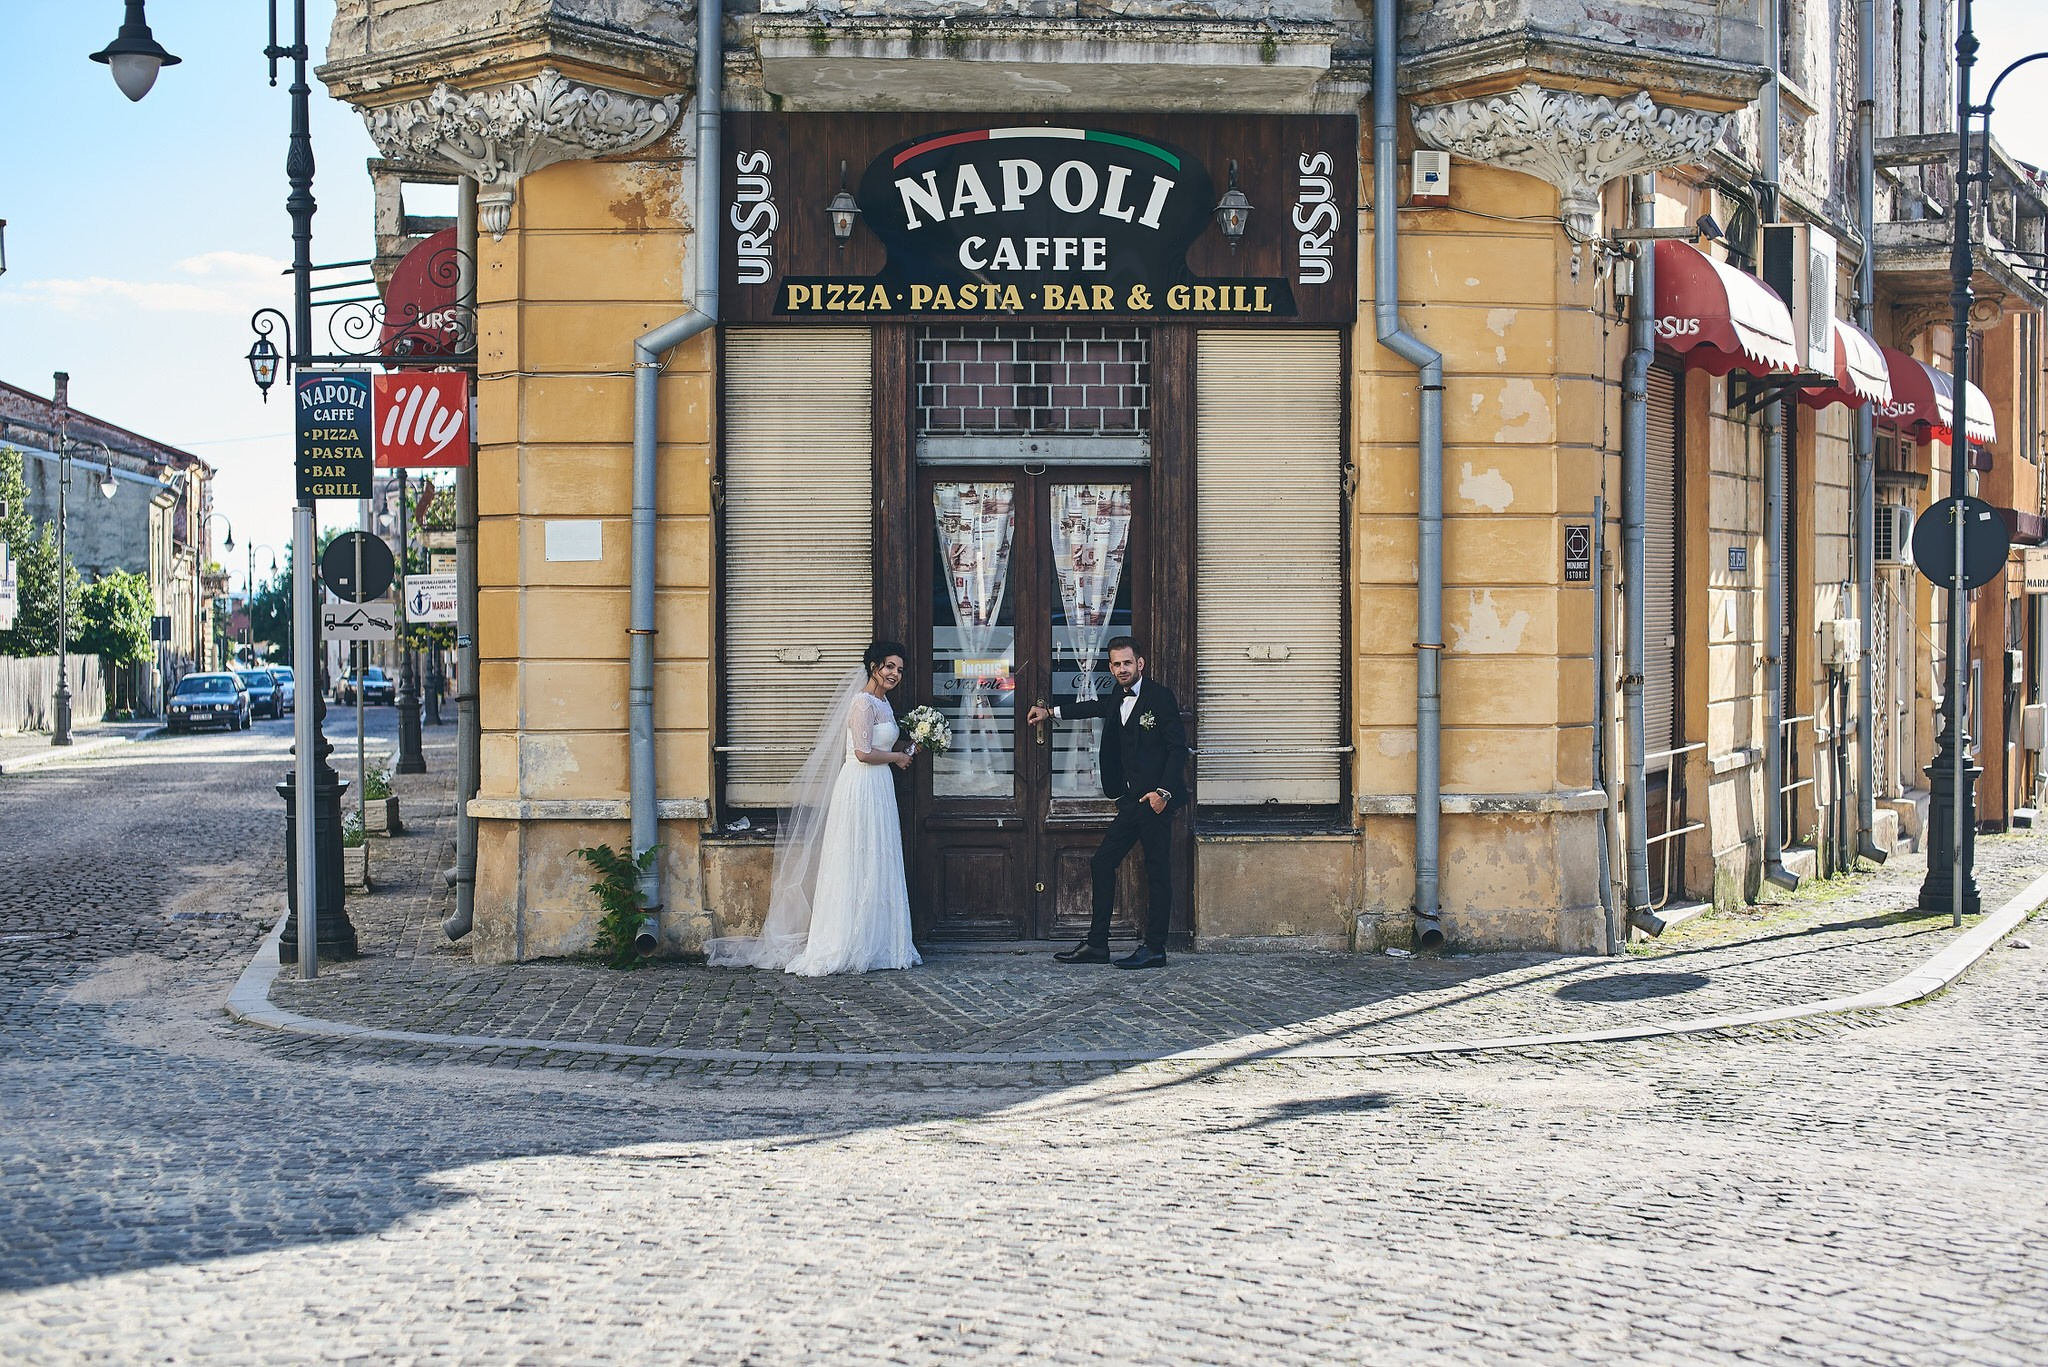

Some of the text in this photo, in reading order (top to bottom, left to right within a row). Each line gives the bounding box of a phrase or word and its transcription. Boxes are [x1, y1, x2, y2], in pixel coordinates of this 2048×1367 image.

[894, 158, 1176, 231] NAPOLI
[730, 149, 779, 285] URSUS
[1292, 151, 1341, 285] URSUS
[959, 235, 1107, 271] CAFFE
[787, 284, 1272, 312] PIZZA PASTA BAR & GRILL
[300, 385, 367, 410] NAPOLI
[313, 409, 355, 422] CAFFE
[381, 384, 464, 460] illy
[312, 429, 359, 441] PIZZA
[312, 447, 364, 459] PASTA
[312, 465, 346, 477] BAR
[312, 483, 361, 496] GRILL
[1567, 571, 1588, 579] ISTORIC
[432, 600, 453, 610] MARIAN
